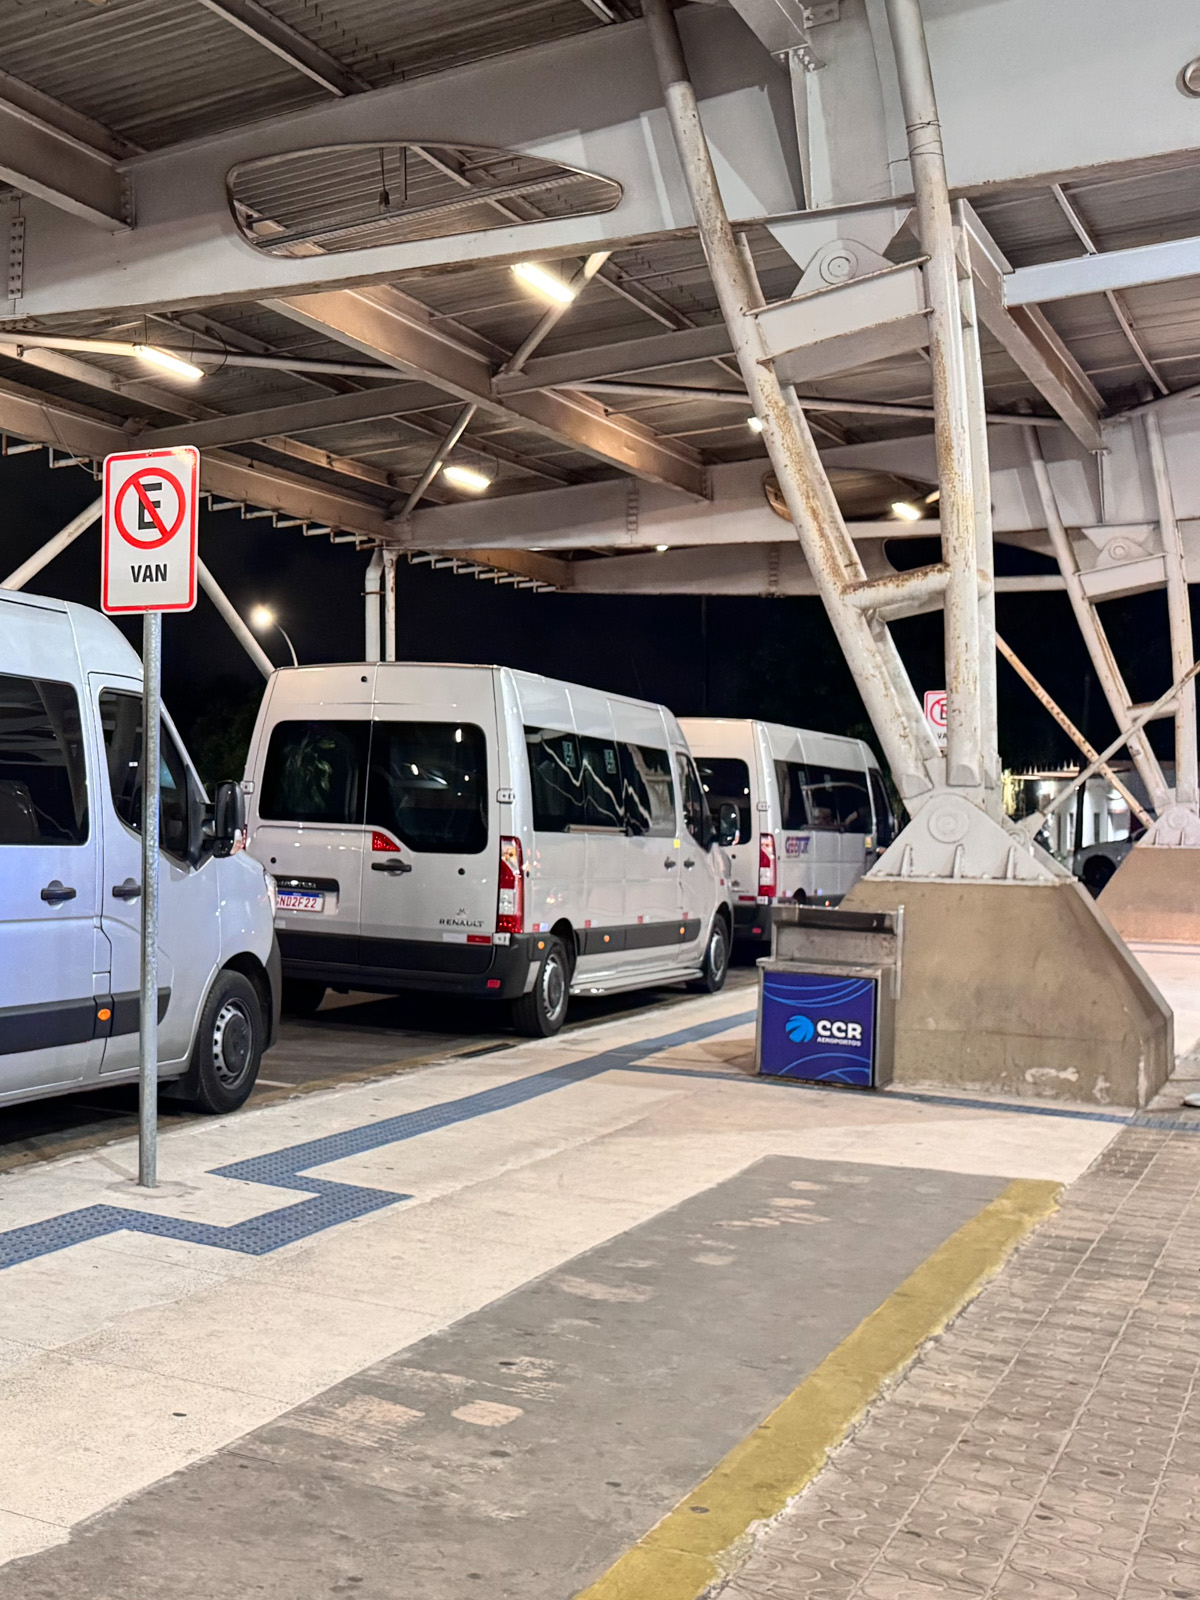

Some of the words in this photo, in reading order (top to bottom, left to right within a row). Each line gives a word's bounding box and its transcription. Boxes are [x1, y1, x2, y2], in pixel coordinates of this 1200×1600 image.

[130, 563, 168, 583] VAN
[276, 896, 318, 909] ND2F22
[439, 918, 484, 928] RENAULT
[816, 1019, 863, 1040] CCR
